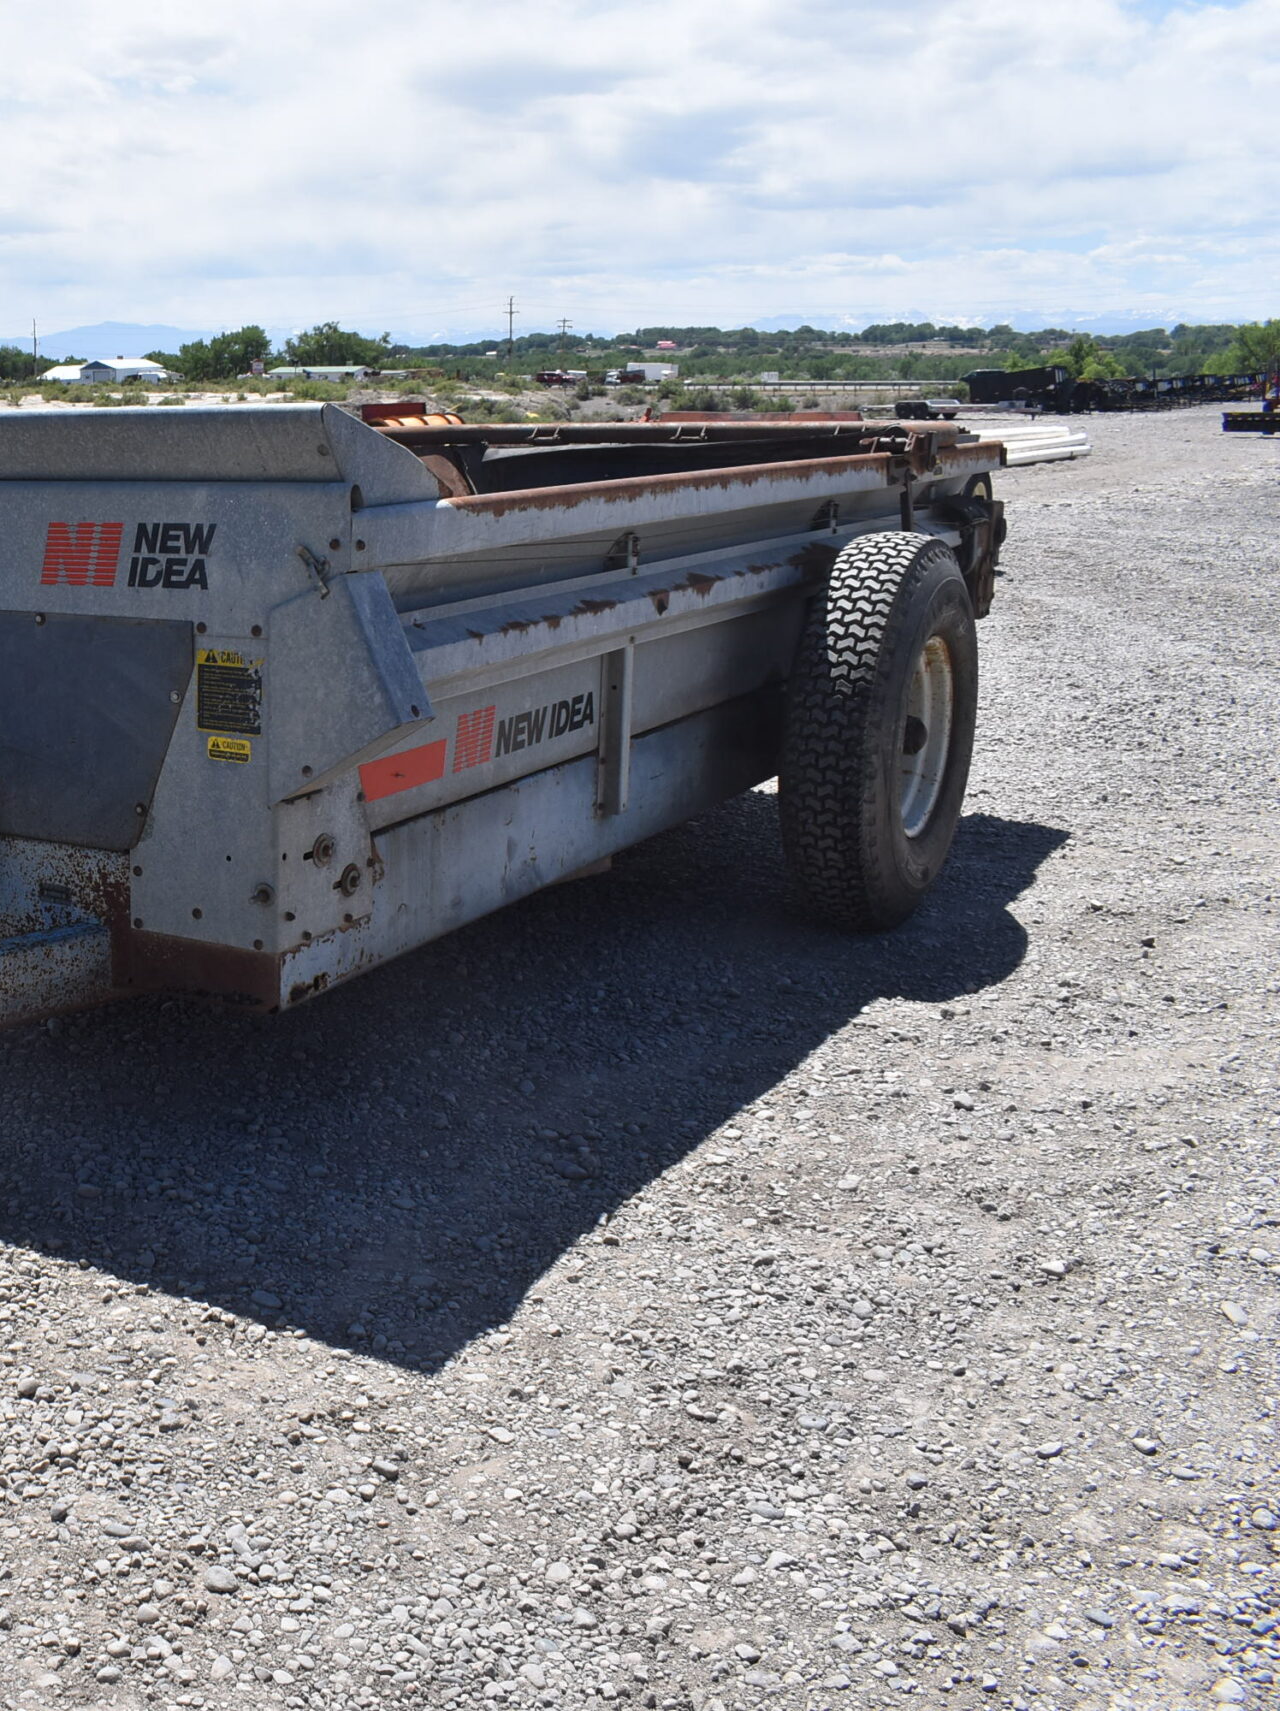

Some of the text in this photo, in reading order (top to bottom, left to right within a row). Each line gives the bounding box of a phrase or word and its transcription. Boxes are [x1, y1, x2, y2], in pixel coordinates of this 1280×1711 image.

[133, 522, 217, 554] NEW
[127, 556, 209, 590] IDEA
[495, 691, 594, 758] NEW IDEA
[222, 741, 246, 752] CAUTION
